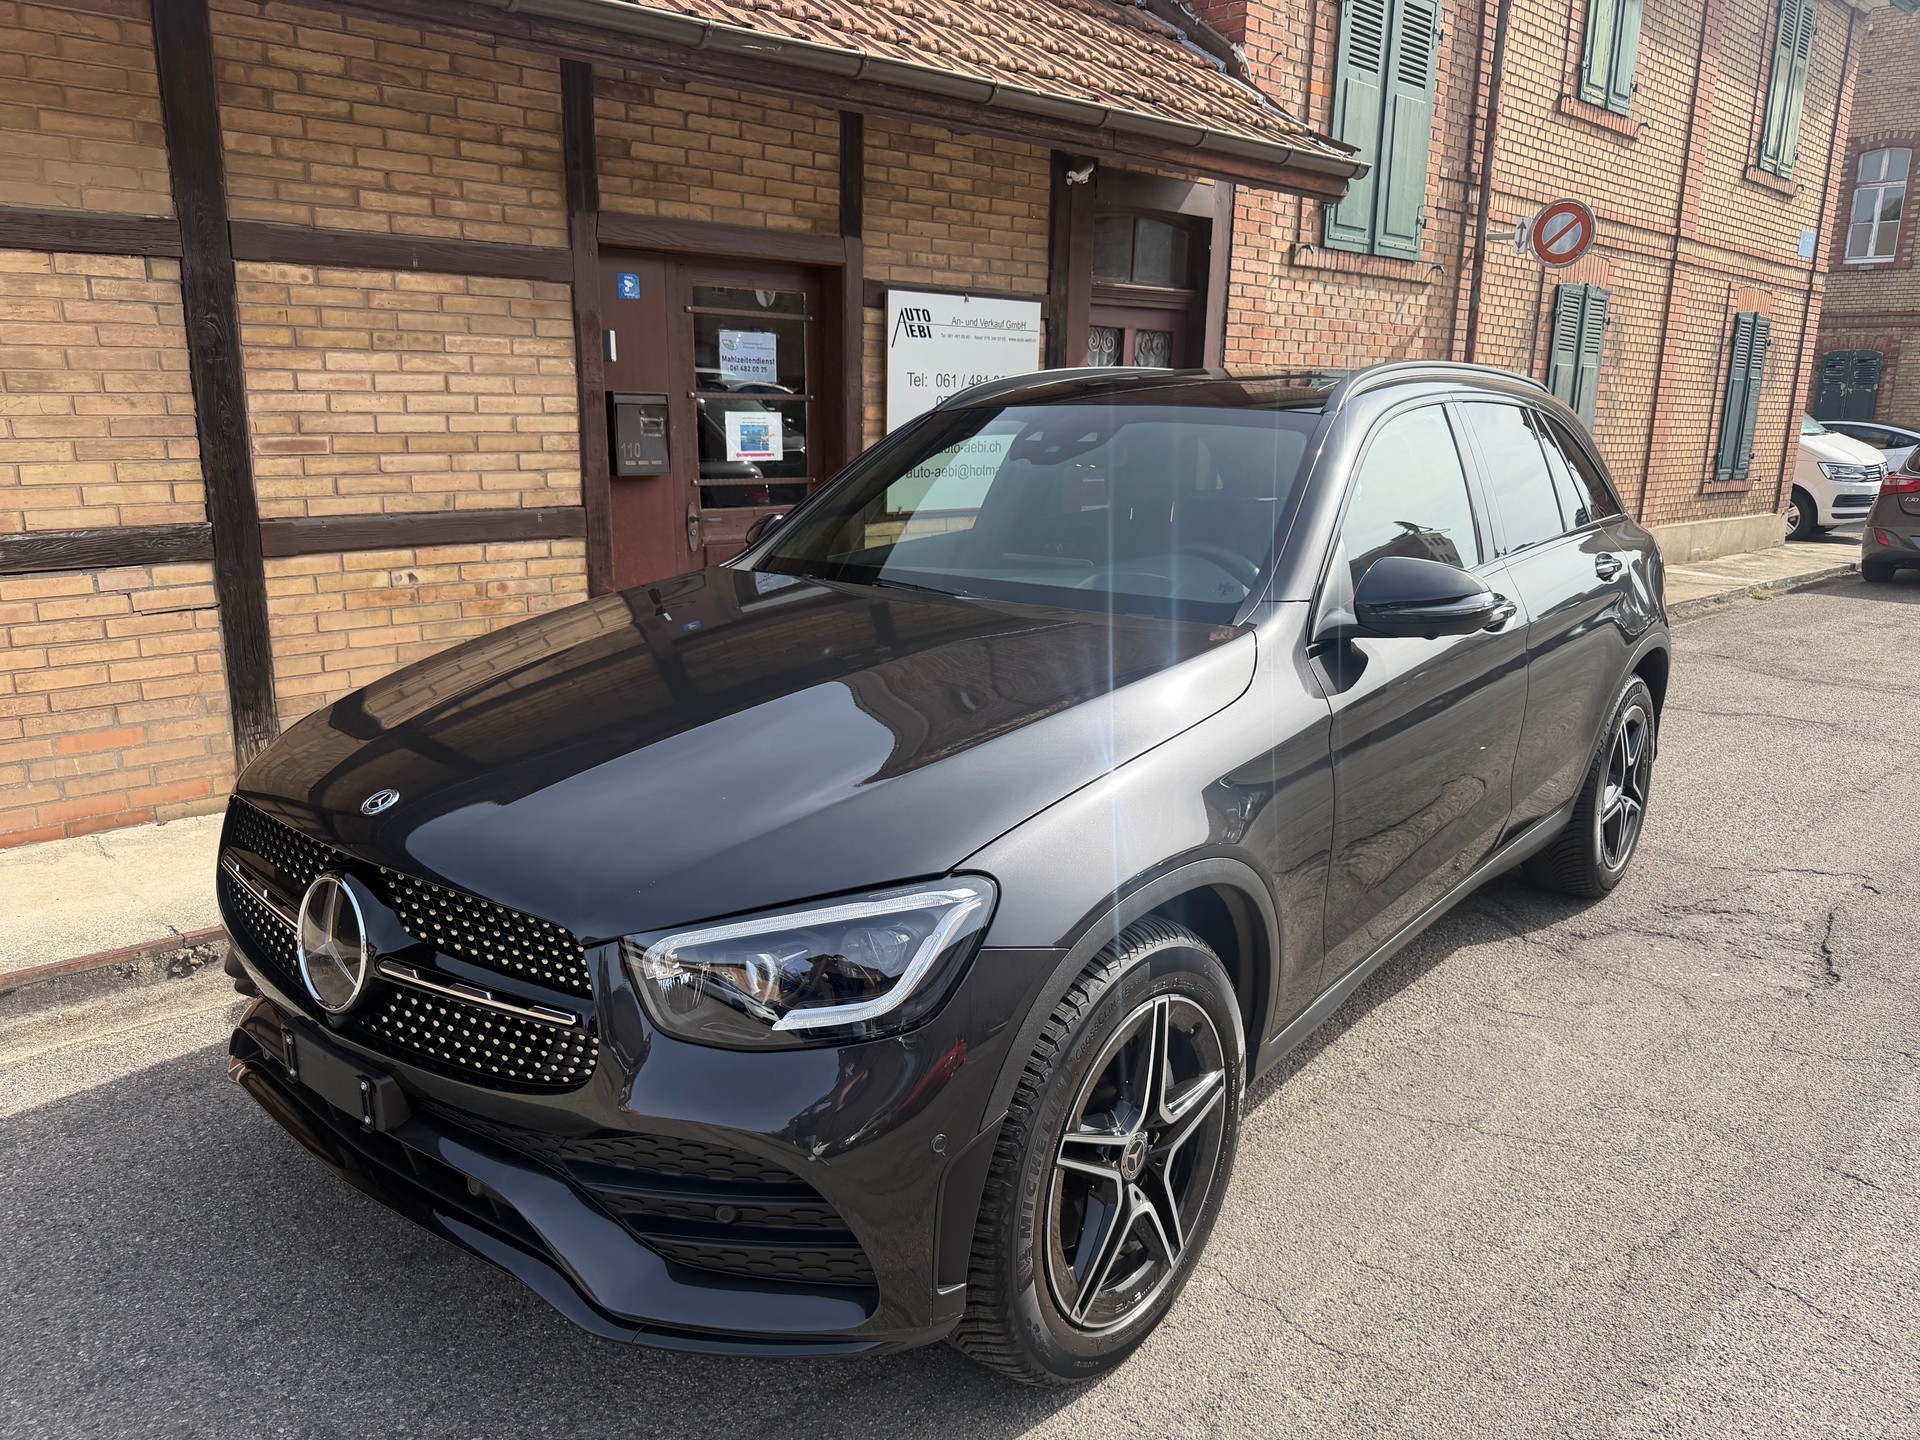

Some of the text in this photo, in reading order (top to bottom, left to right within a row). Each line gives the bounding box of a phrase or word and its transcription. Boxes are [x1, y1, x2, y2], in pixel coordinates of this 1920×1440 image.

[951, 315, 1027, 331] An- und Verkauf GmbH
[721, 354, 775, 365] Mahlzeitendienst
[740, 365, 752, 373] 482
[906, 372, 928, 387] Tel:
[935, 373, 957, 388] 061
[621, 442, 641, 458] 110
[1019, 1063, 1074, 1239] MICHELIN
